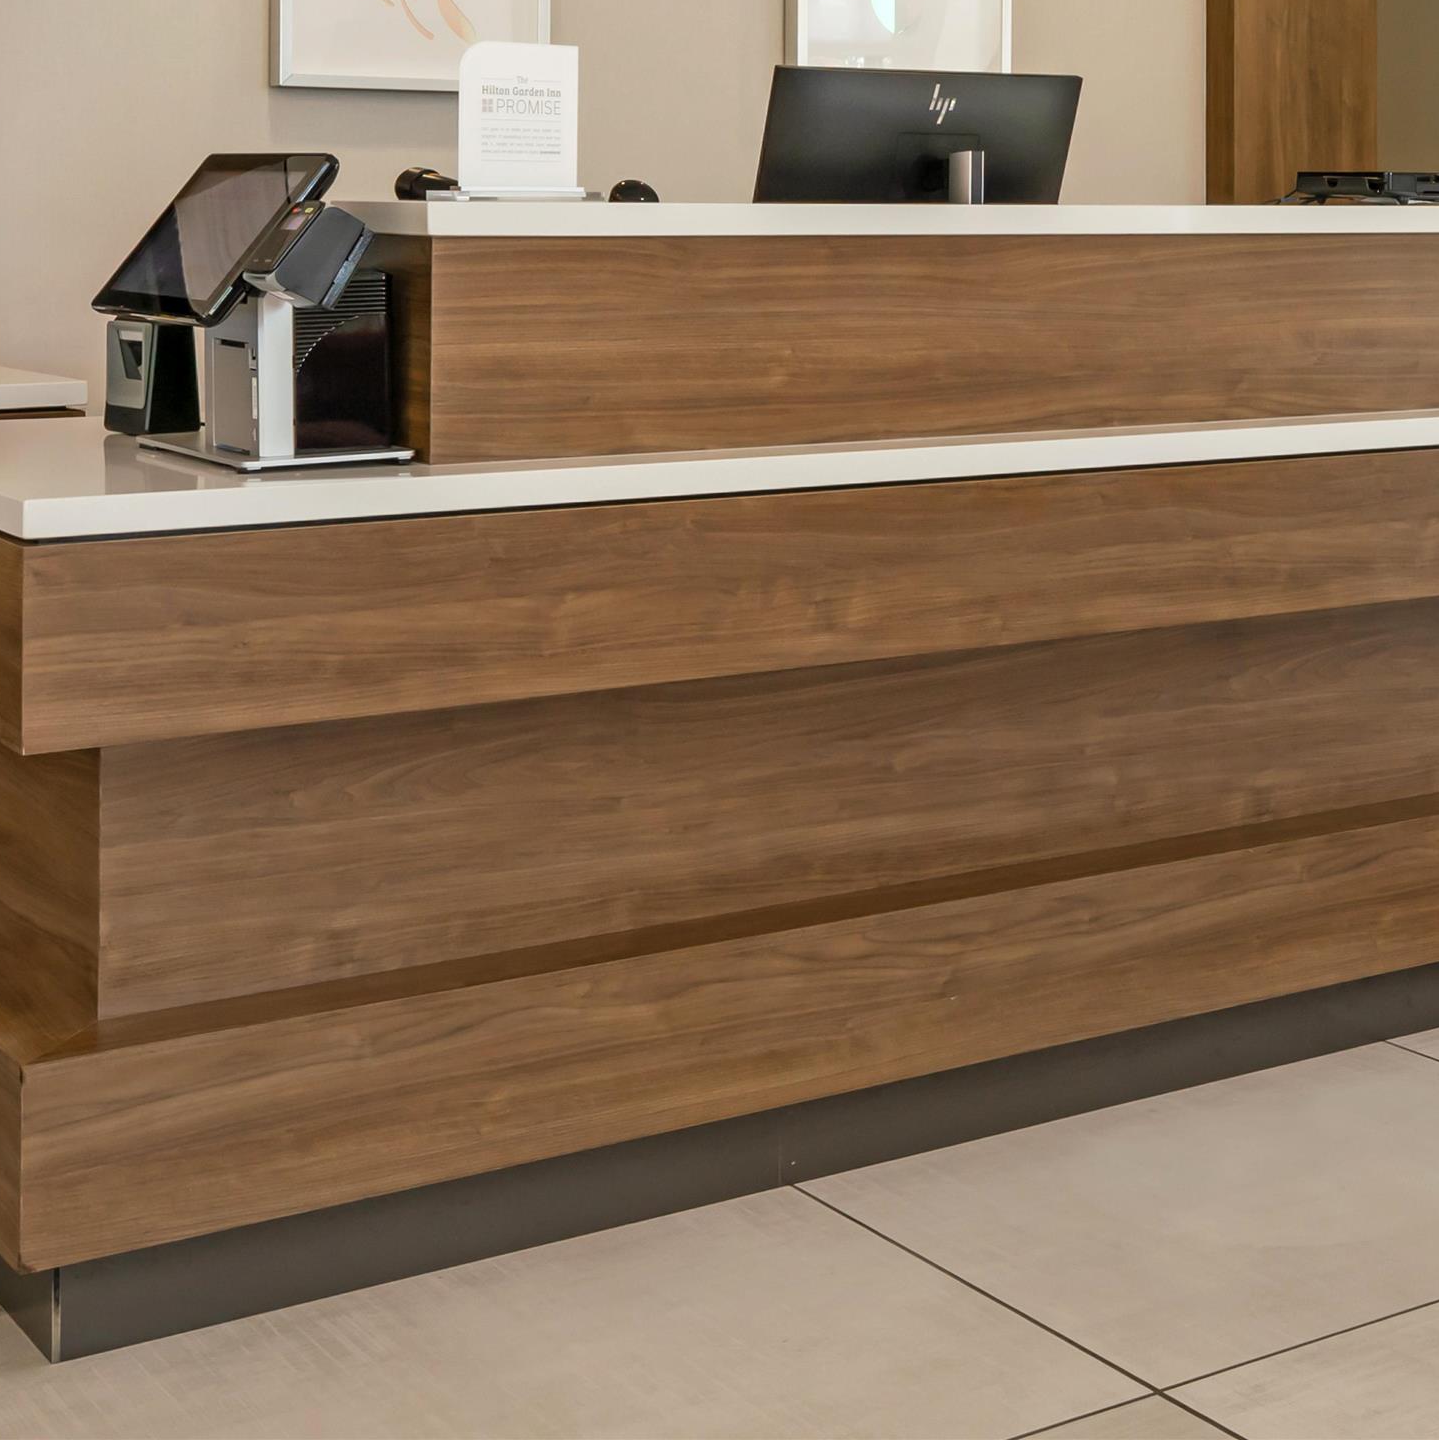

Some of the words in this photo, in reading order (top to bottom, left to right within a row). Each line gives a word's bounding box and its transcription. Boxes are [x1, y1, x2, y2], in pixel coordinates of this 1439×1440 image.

[481, 85, 510, 96] Hilton
[512, 86, 544, 98] Garden
[547, 88, 561, 98] Inn
[496, 98, 562, 116] PROMISE
